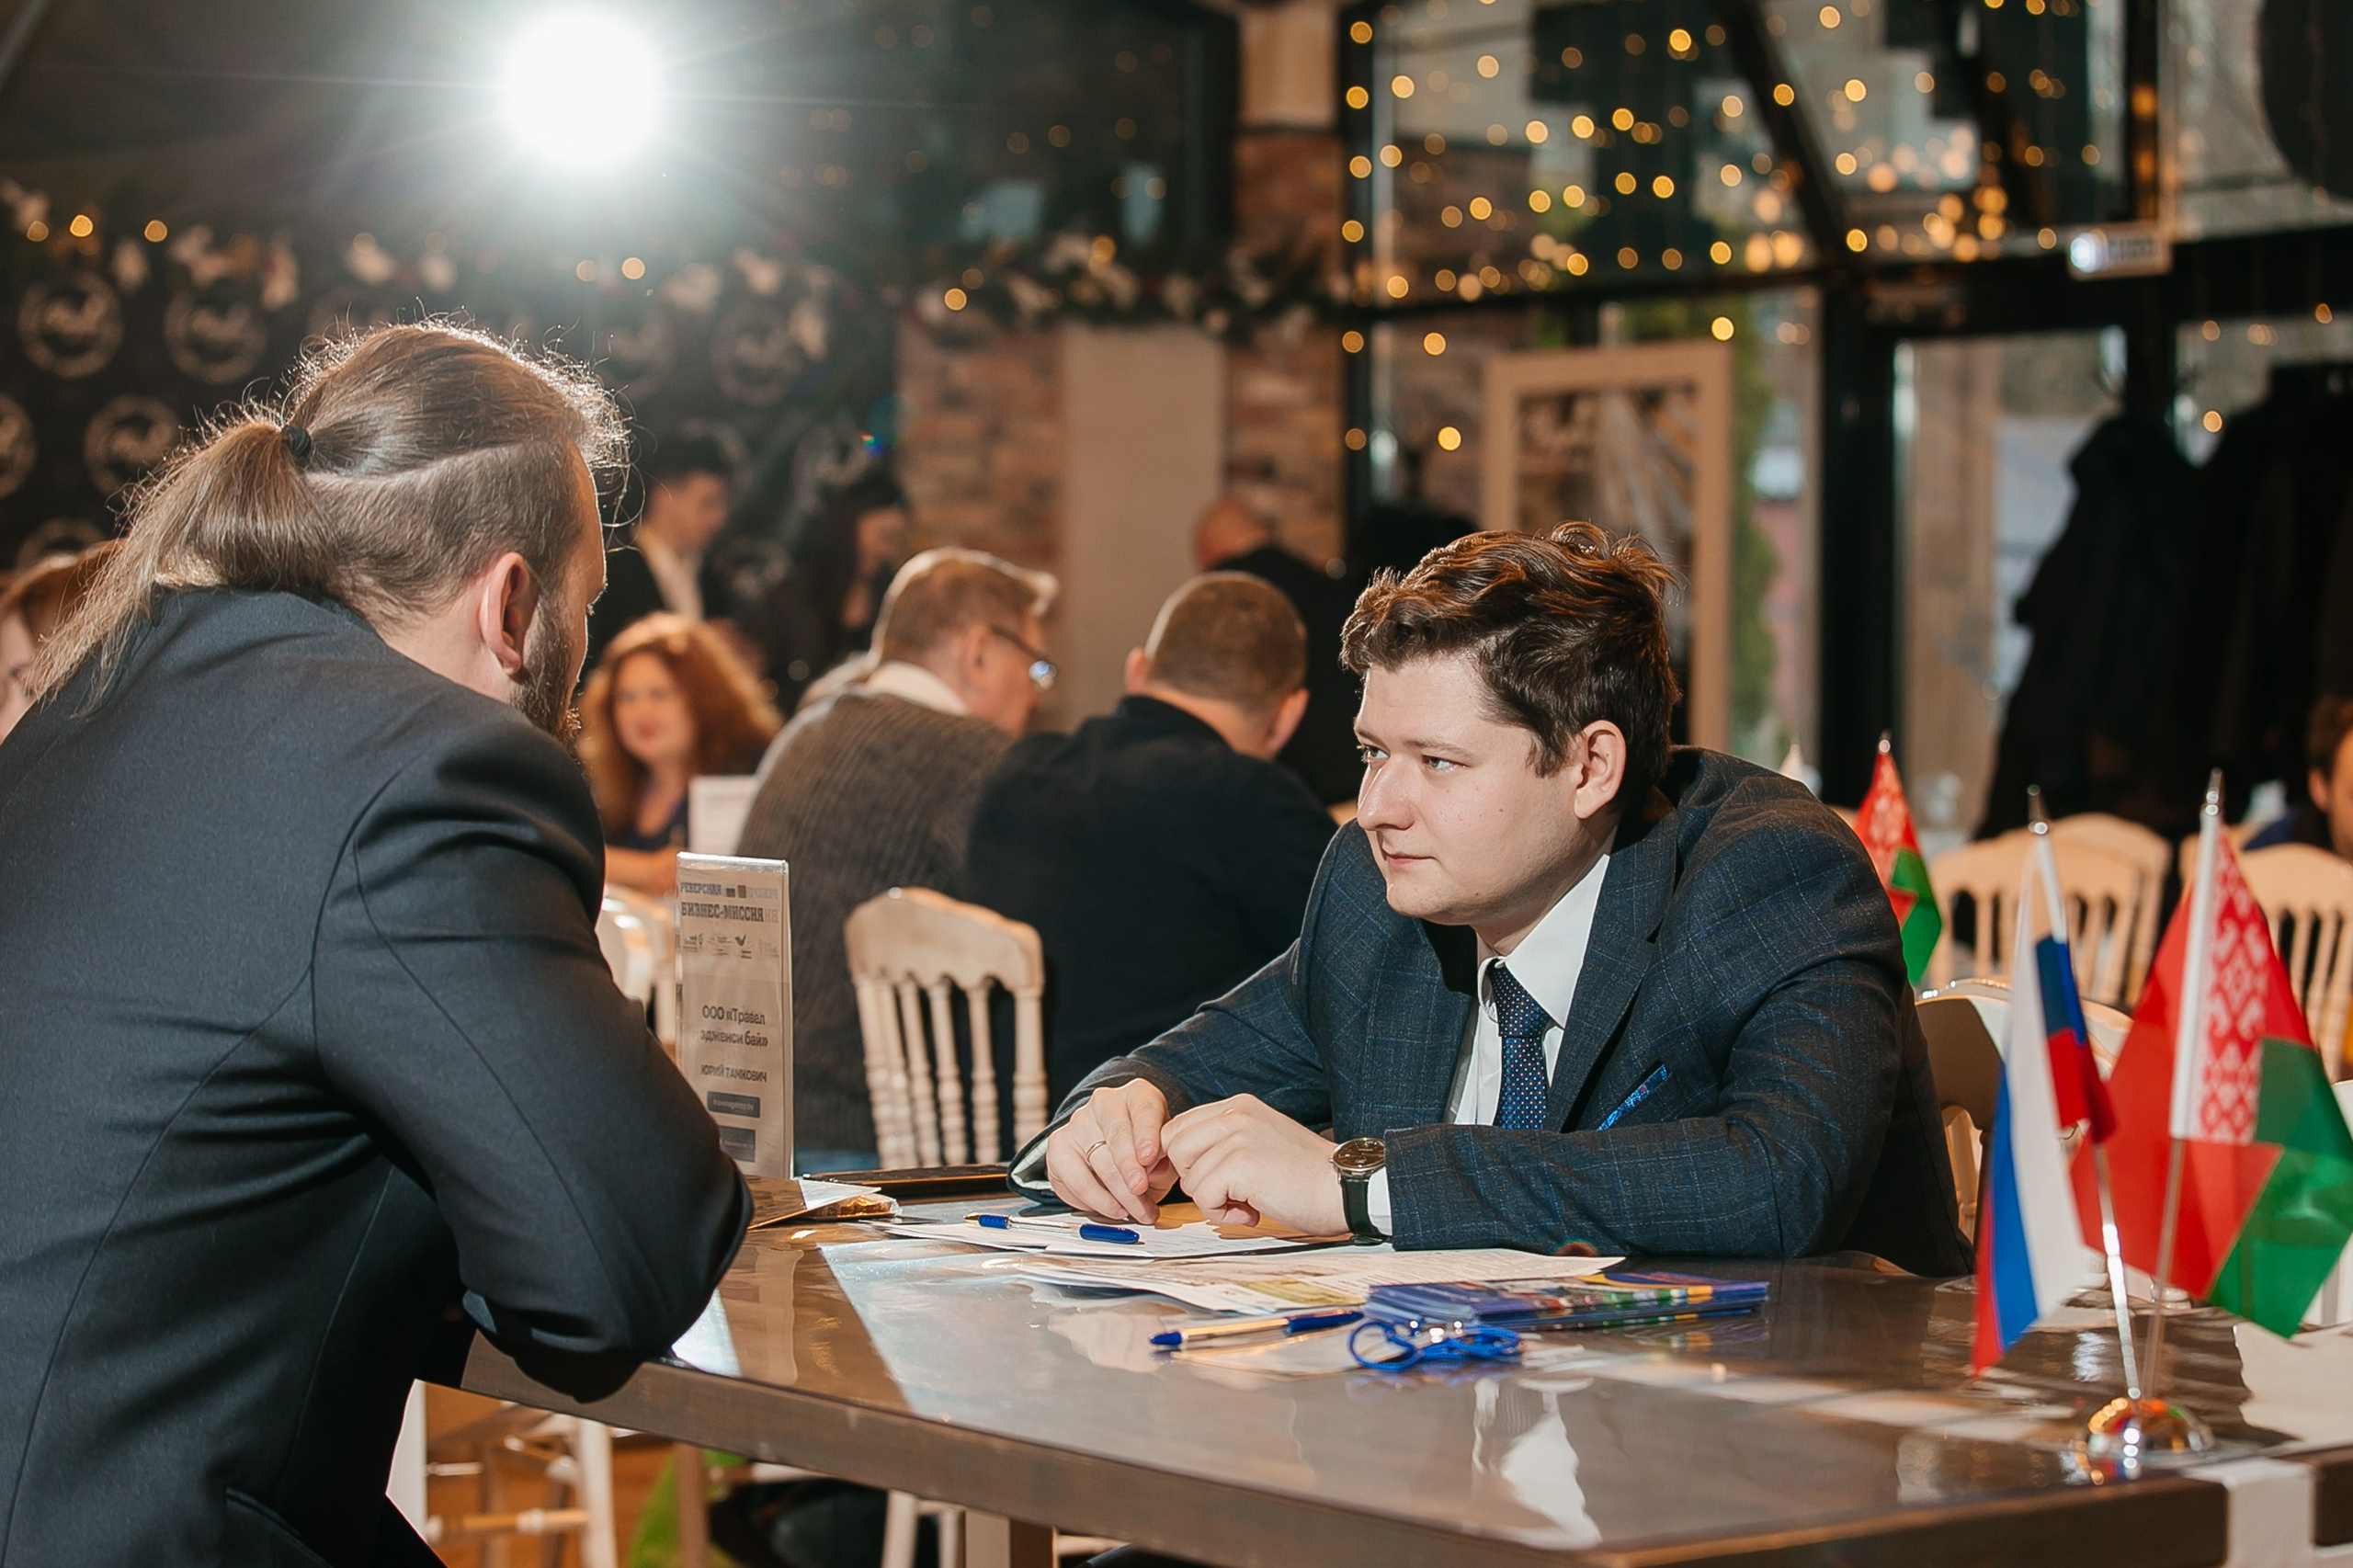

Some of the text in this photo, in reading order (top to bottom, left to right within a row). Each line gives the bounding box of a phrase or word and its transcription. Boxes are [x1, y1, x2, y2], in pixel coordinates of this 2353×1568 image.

[680, 881, 722, 896] РЕВЕРСНАЯ
[681, 902, 764, 922] БИЗНЕС-МИССИЯ
[702, 1005, 766, 1025] ООО «Травел
[745, 1030, 768, 1047] бай»
[700, 1063, 724, 1078] ЮРИЙ
